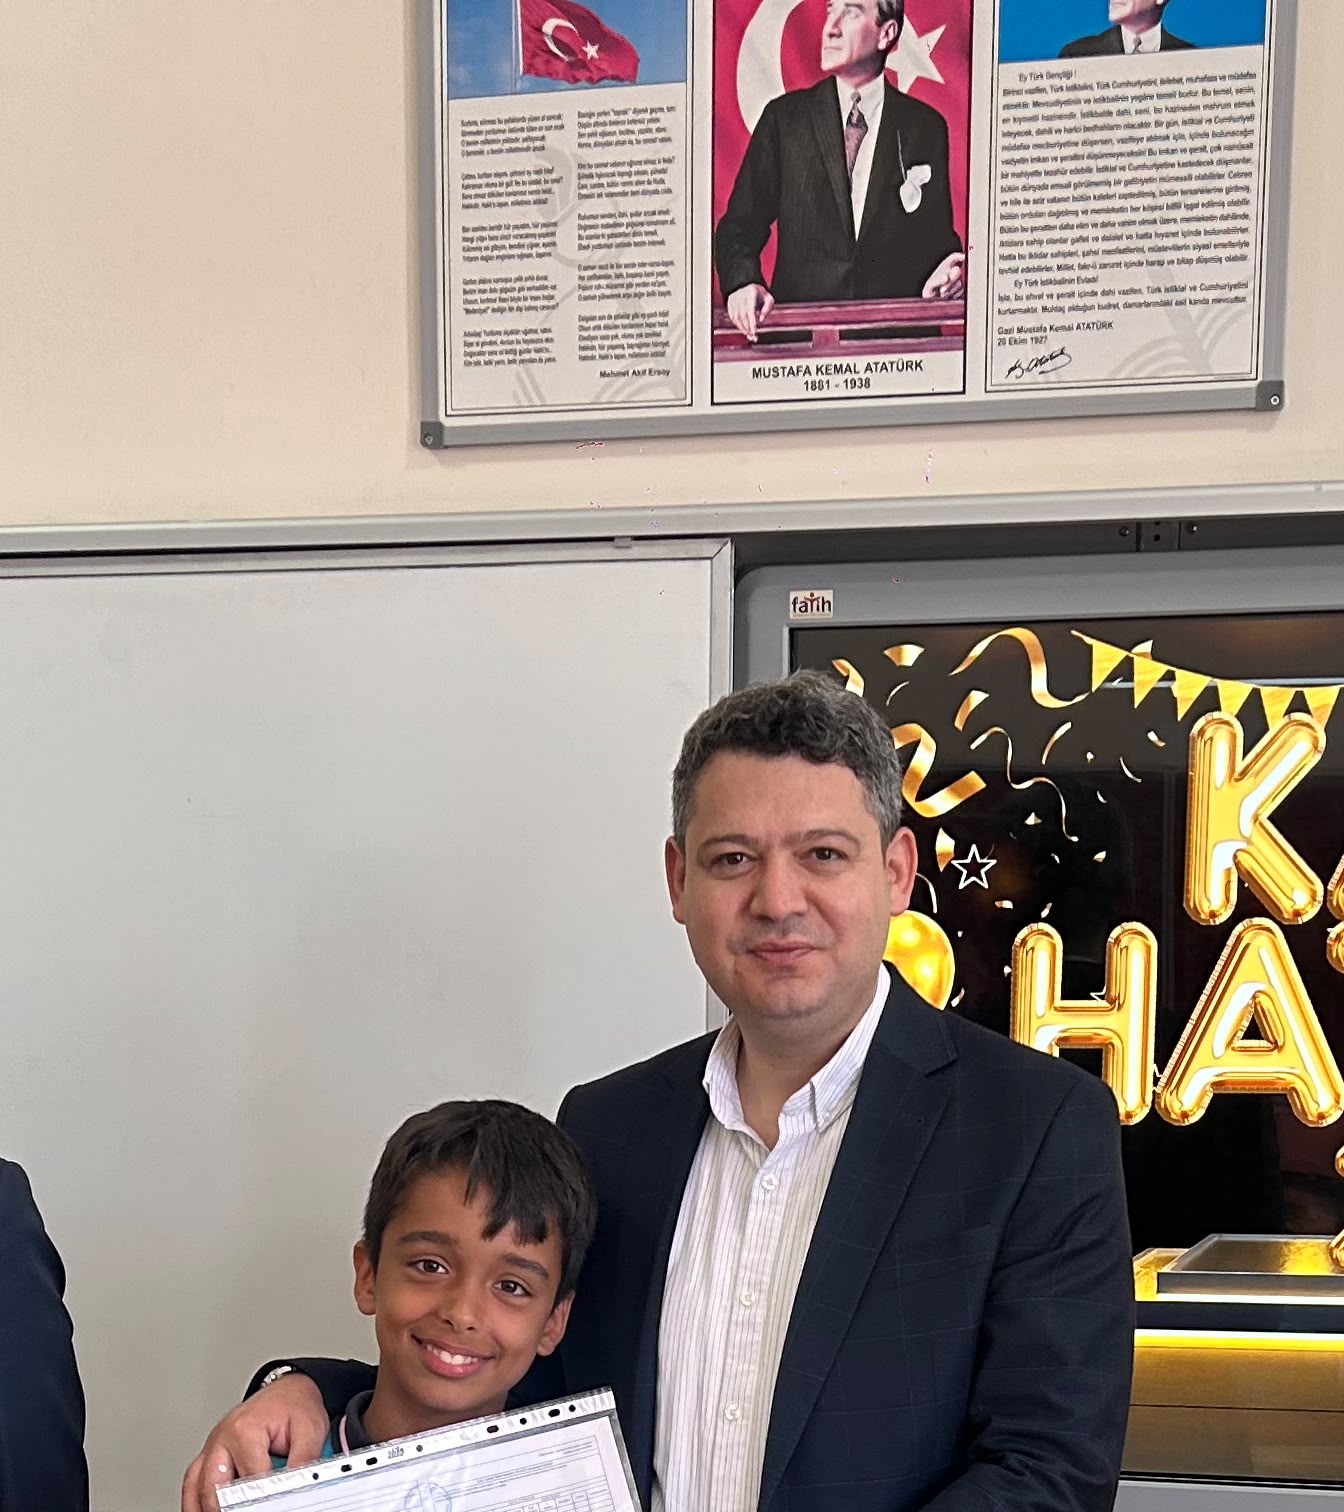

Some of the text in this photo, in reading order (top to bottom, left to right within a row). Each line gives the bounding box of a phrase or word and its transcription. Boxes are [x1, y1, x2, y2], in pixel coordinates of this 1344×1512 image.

[1017, 325, 1047, 333] Mustafa
[1049, 324, 1074, 332] Kemal
[1076, 320, 1113, 330] ATATÜRK
[752, 358, 924, 379] MUSTAFA KEMAL ATATÜRK
[803, 379, 831, 392] 1881
[843, 377, 871, 390] 1938
[791, 592, 832, 613] fatih
